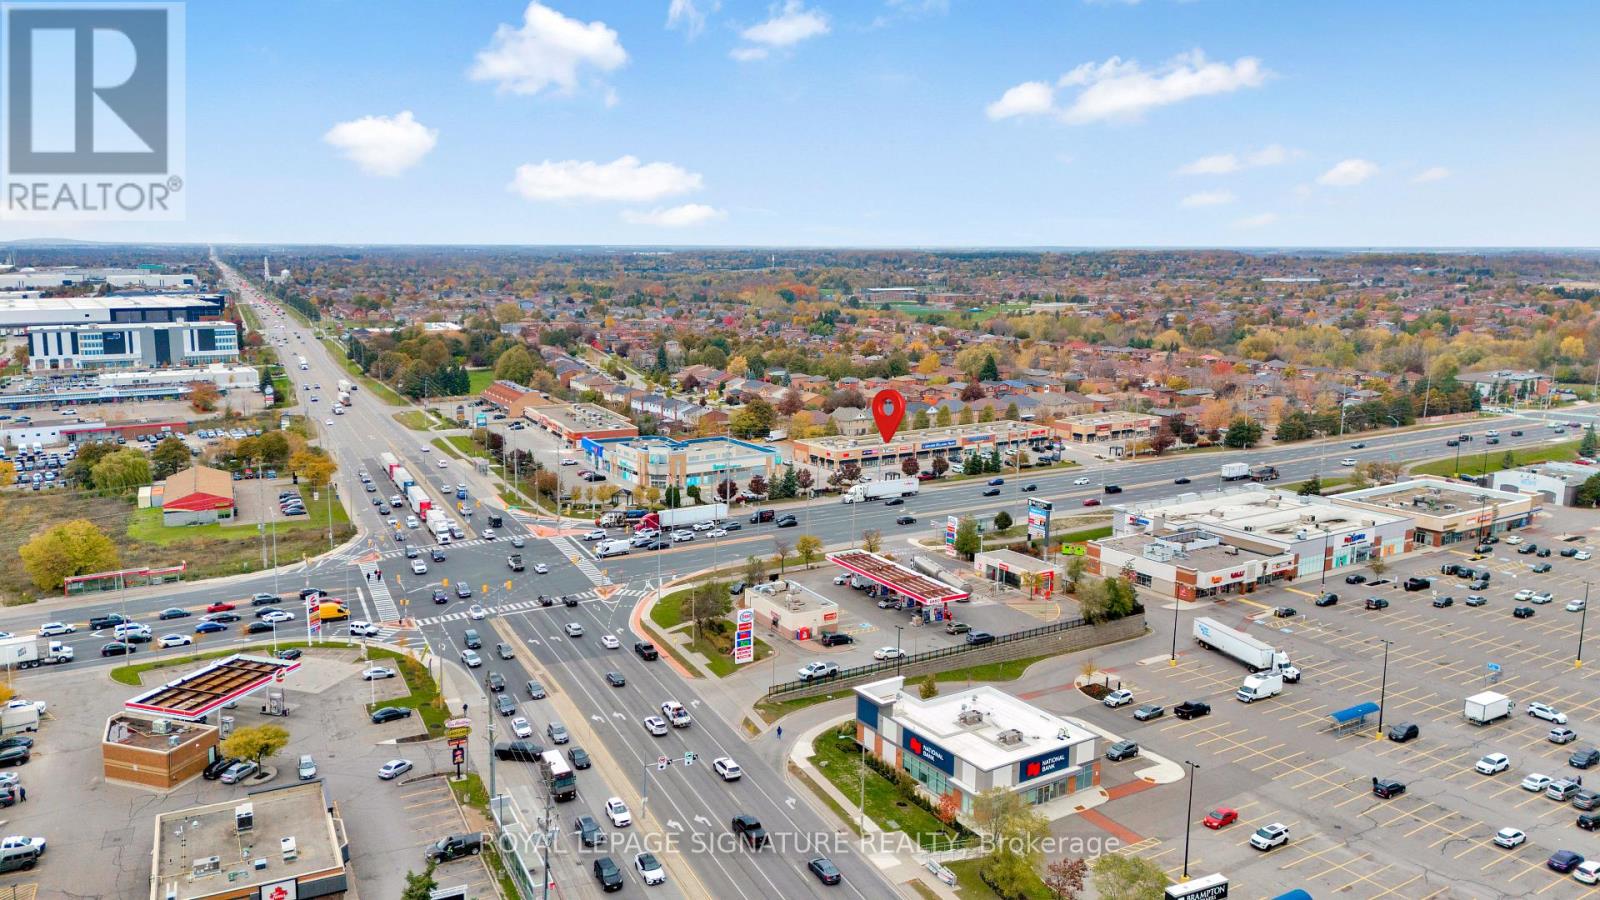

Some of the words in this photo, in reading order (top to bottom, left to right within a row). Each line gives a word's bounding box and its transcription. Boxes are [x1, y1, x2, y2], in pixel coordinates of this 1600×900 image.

[922, 745, 944, 761] NATIONAL
[922, 750, 935, 762] BANK
[1042, 755, 1065, 766] NATIONAL
[1041, 764, 1055, 772] BANK
[1186, 884, 1226, 900] BRAMPTON
